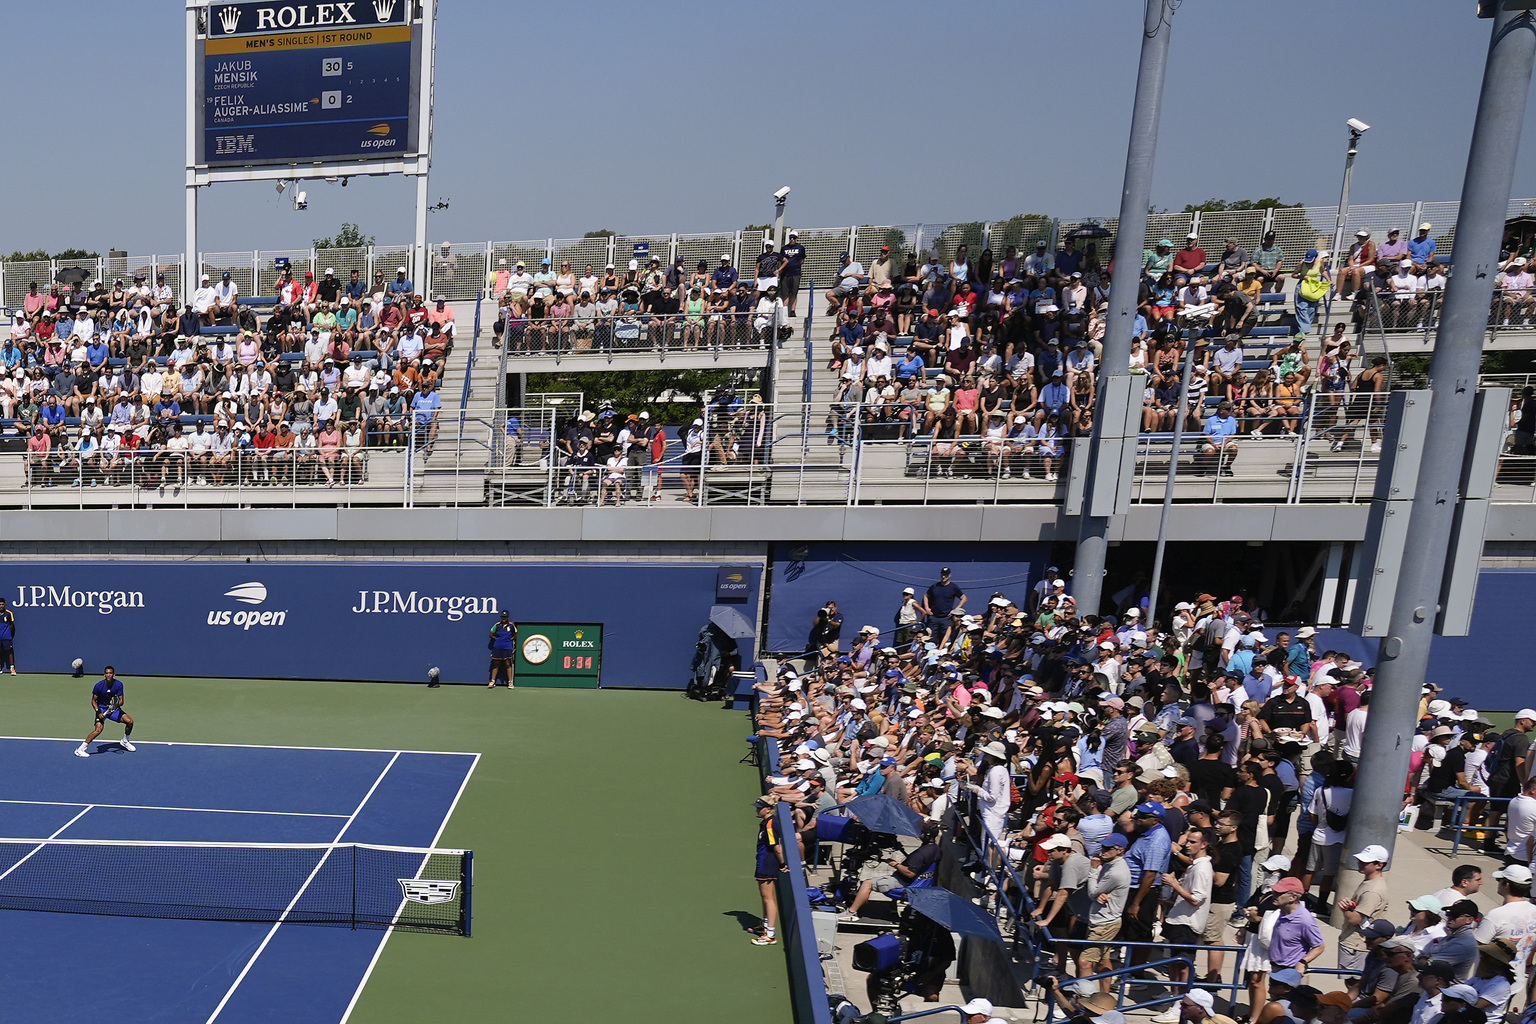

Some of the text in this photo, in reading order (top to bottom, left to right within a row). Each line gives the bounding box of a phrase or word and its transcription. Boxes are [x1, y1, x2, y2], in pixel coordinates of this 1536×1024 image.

[256, 3, 356, 30] ROLEX
[246, 32, 373, 49] MEN'S SINGLES 1ST ROUND
[214, 60, 252, 73] JAKUB
[325, 62, 340, 72] 30
[347, 62, 353, 70] 5
[214, 71, 258, 84] MENSIK
[214, 95, 245, 106] FELIX
[328, 95, 336, 105] 0
[346, 95, 353, 103] 2
[214, 102, 309, 117] AUGER-ALIASSIME
[215, 134, 257, 154] IBM
[361, 138, 396, 149] us open
[12, 585, 145, 614] J.P.Morgan
[352, 590, 499, 621] J.P.Morgan
[207, 610, 286, 630] us open
[562, 640, 594, 648] ROLEX
[563, 655, 592, 669] 0:34
